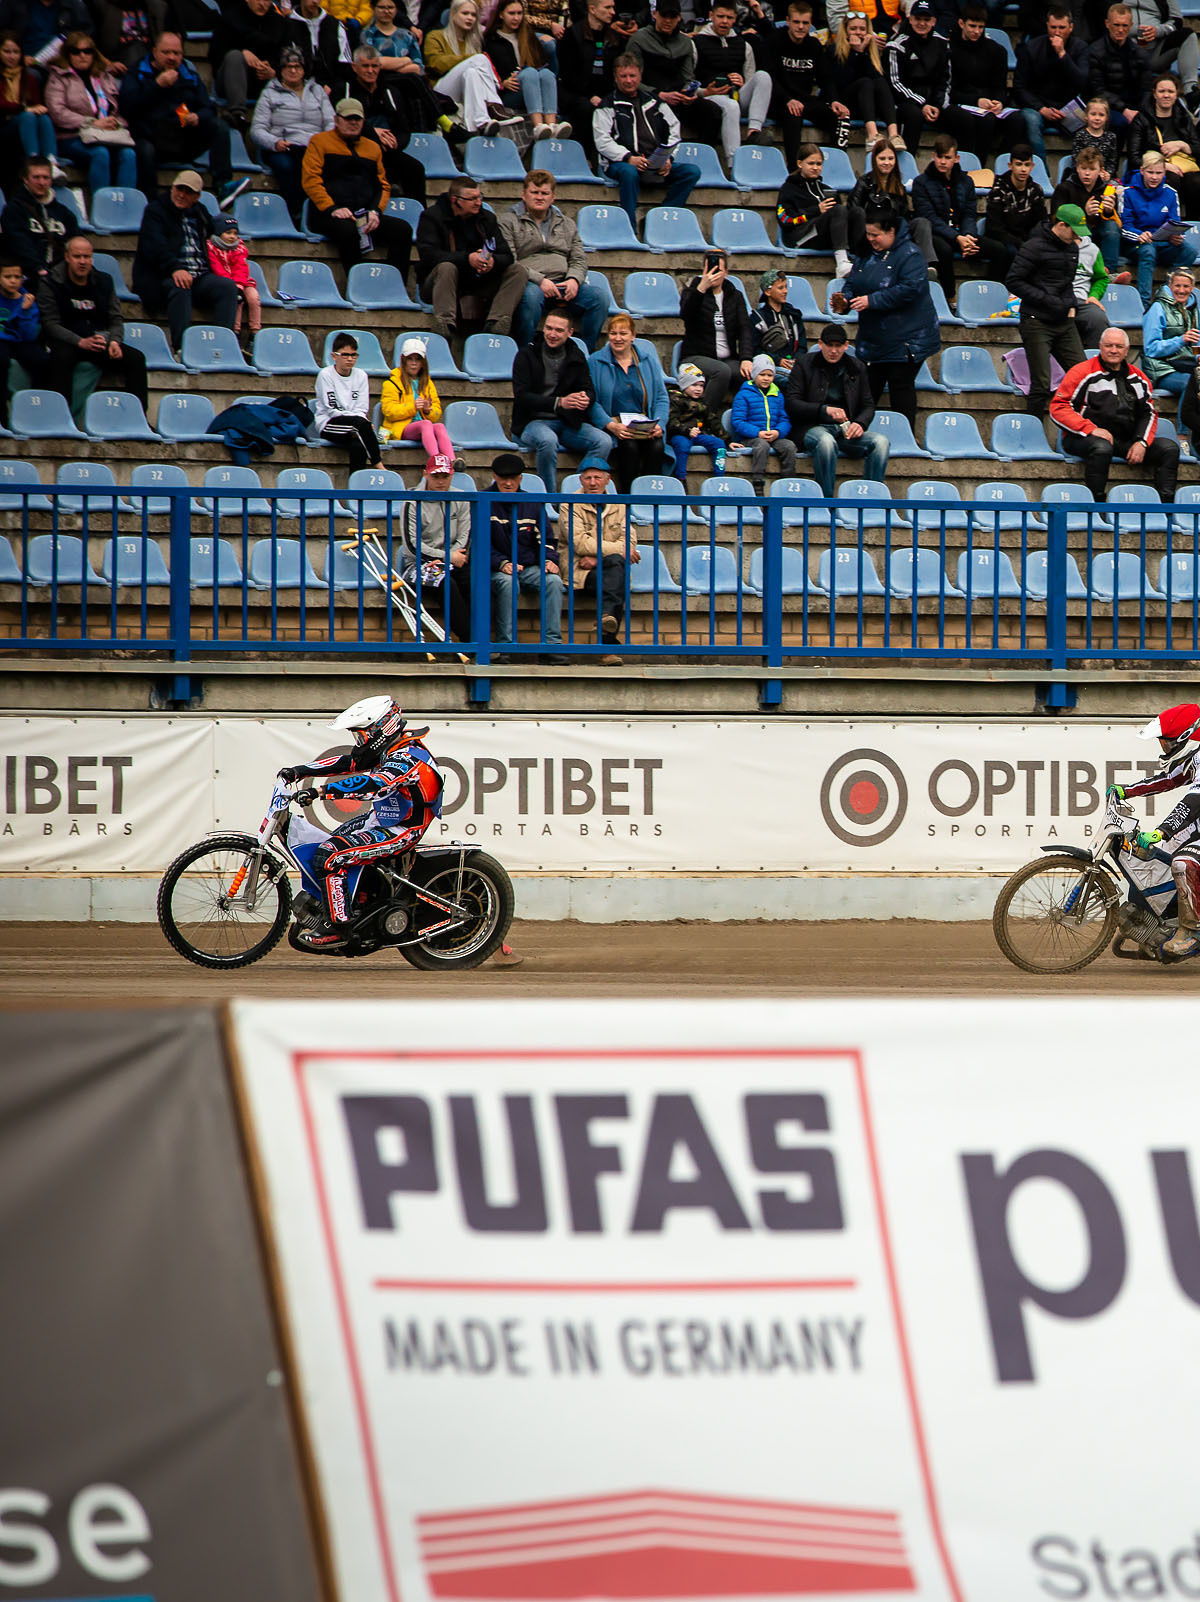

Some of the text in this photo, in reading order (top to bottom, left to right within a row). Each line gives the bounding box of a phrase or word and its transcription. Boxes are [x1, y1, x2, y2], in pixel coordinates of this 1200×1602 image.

[434, 757, 664, 816] OPTIBET
[43, 819, 133, 836] BĀRS
[440, 820, 663, 837] PORTA BĀRS
[927, 824, 1058, 837] SPORTA
[339, 1091, 847, 1235] PUFAS
[383, 1314, 867, 1377] MADE IN GERMANY
